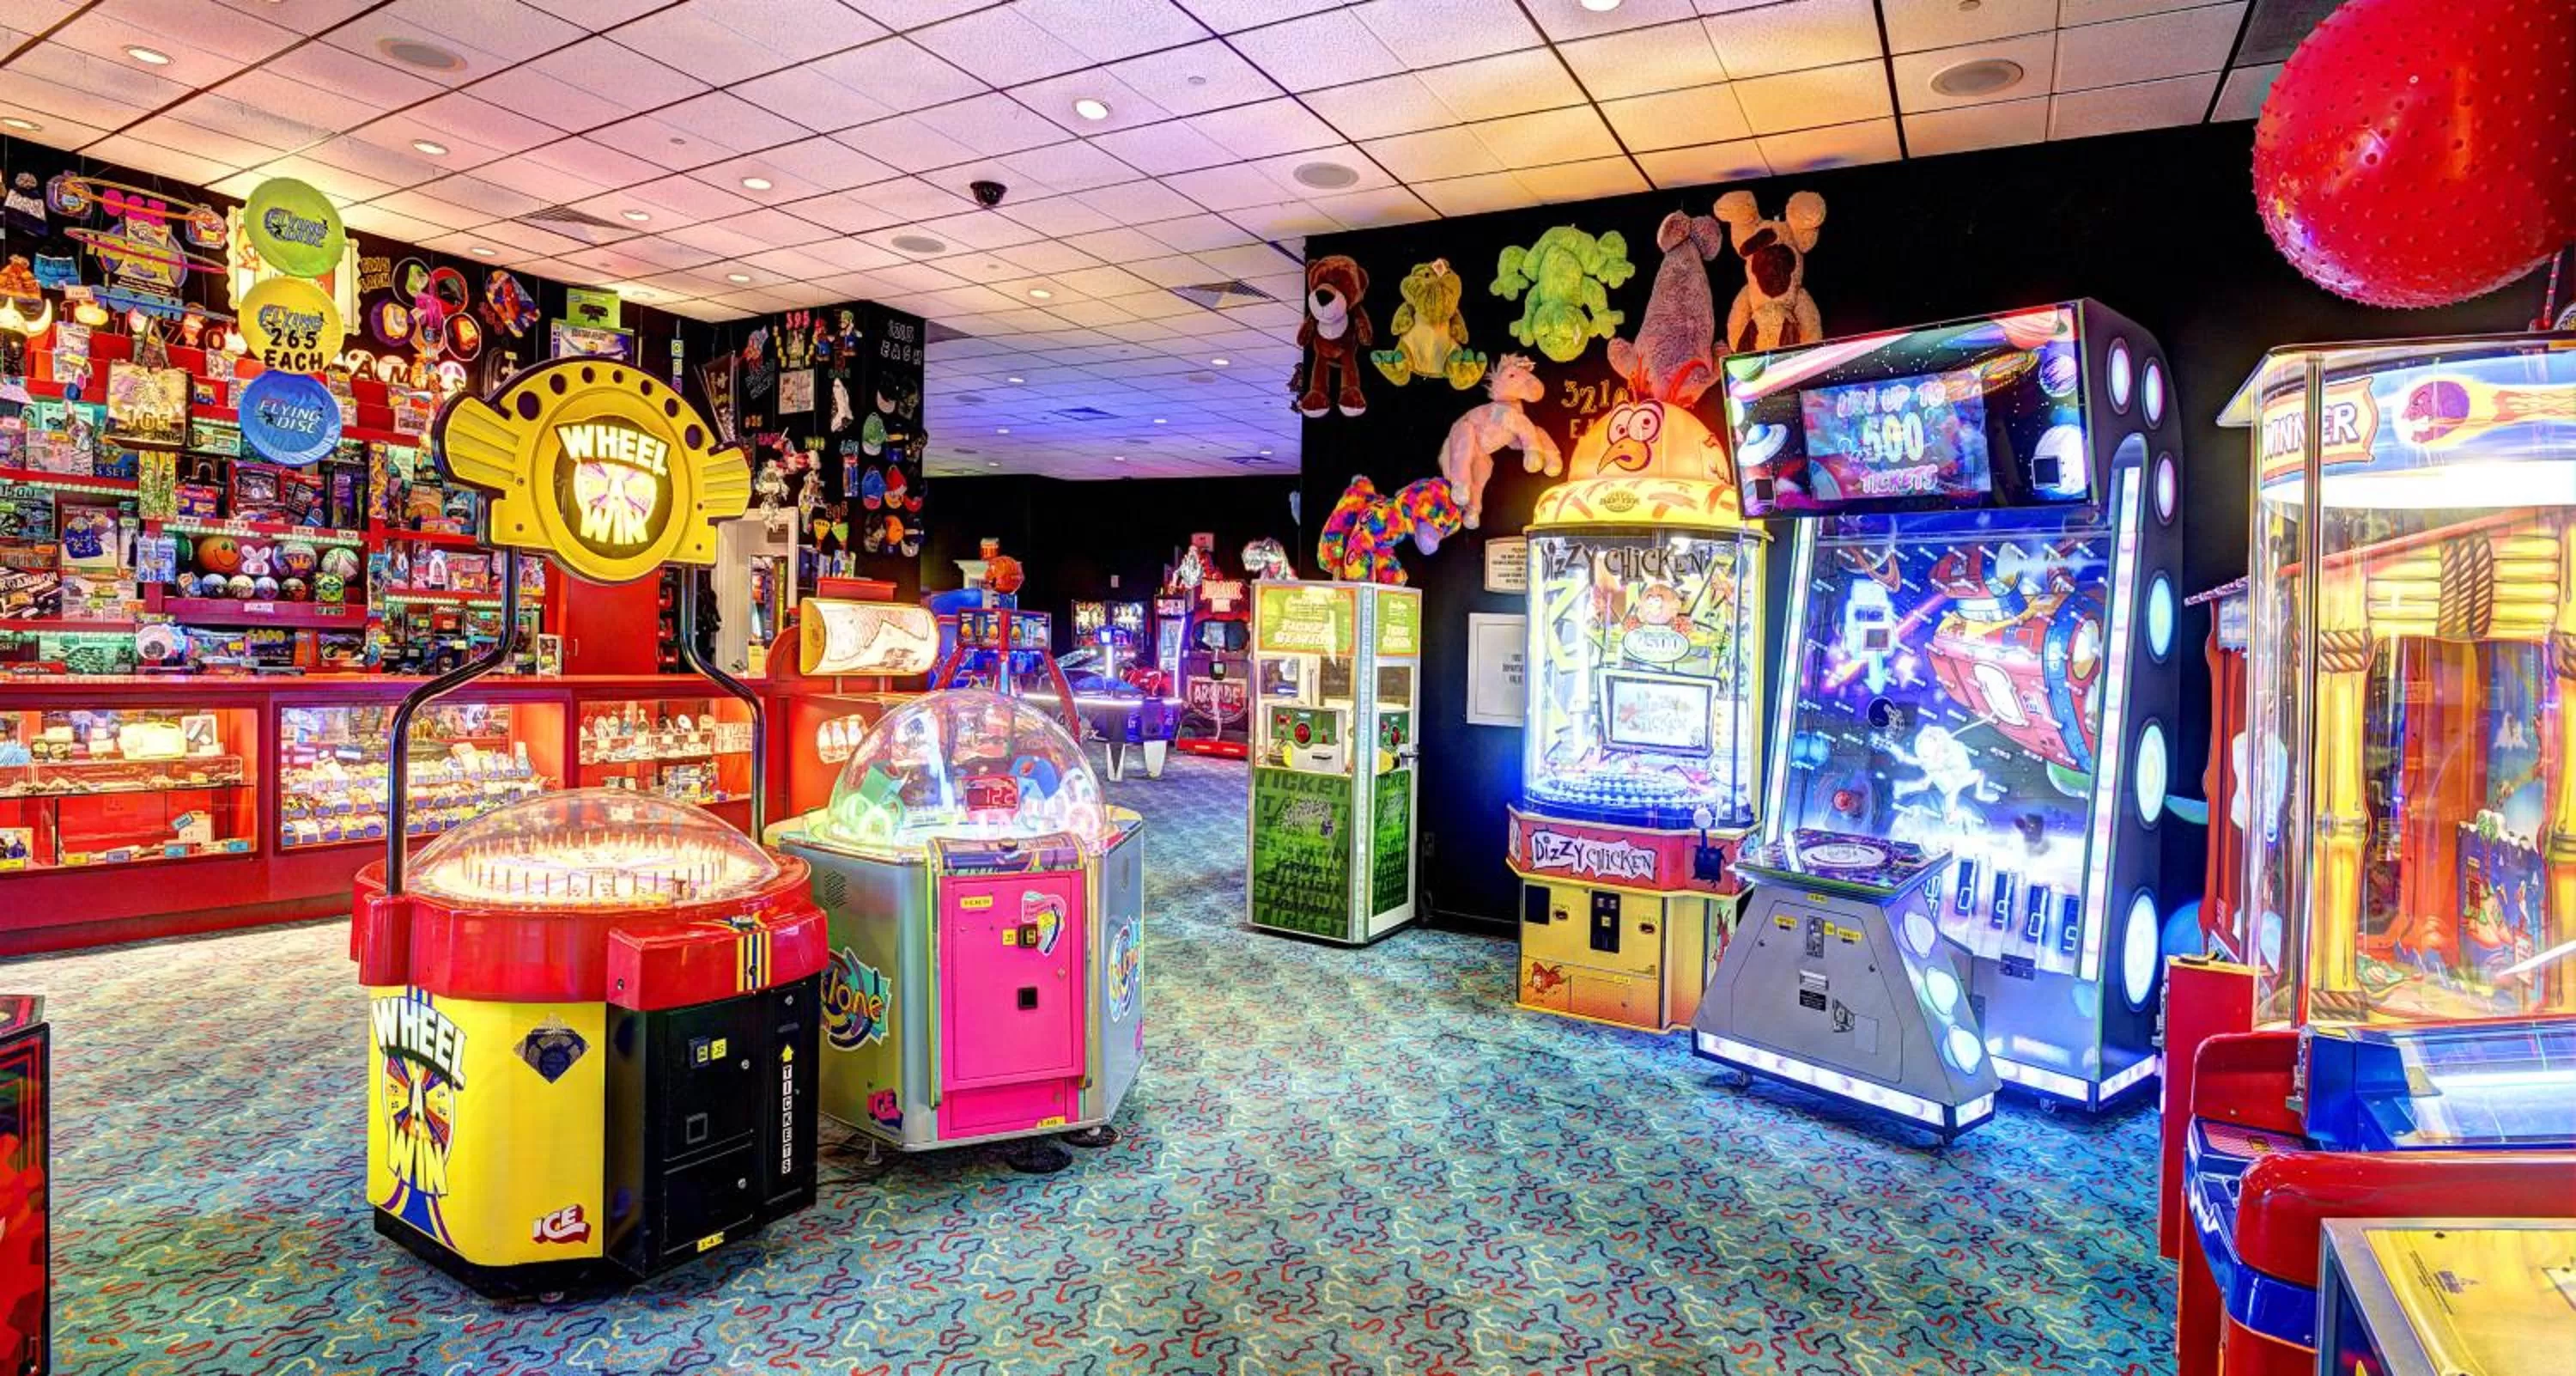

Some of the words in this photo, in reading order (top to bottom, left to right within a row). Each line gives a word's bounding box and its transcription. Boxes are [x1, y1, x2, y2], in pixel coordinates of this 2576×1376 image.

[271, 330, 317, 349] 265
[264, 350, 324, 373] EACH
[258, 399, 322, 422] FLYING
[1881, 385, 1911, 411] UP
[1917, 381, 1947, 407] TO
[129, 411, 169, 429] 165
[276, 416, 317, 434] DISC
[557, 424, 670, 476] WHEEL
[1862, 412, 1925, 464] 500
[1860, 465, 1939, 495] TICKETS
[580, 507, 648, 545] WIN
[1255, 770, 1347, 797] TICKET
[822, 967, 884, 1022] lone
[371, 996, 467, 1088] WHEEL
[782, 1065, 793, 1174] TICKETS
[388, 1119, 448, 1197] WIN
[532, 1204, 591, 1243] ICE
